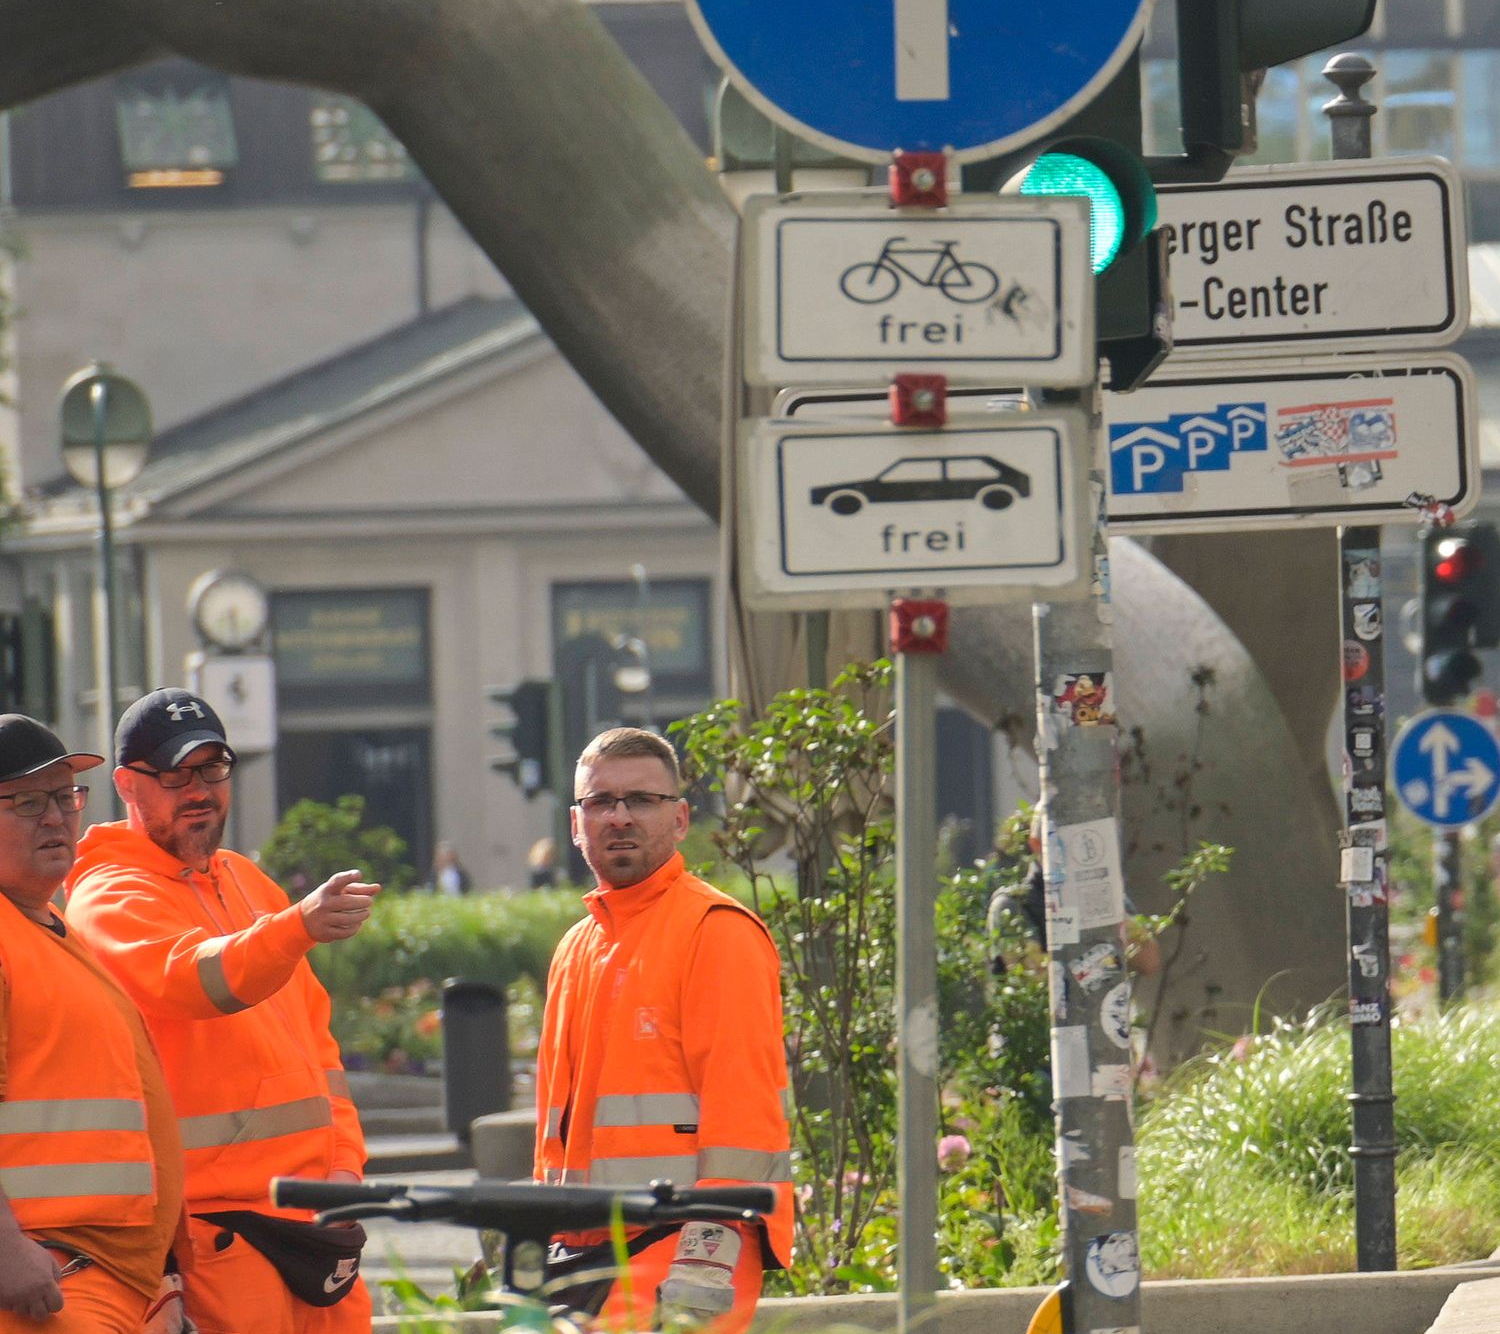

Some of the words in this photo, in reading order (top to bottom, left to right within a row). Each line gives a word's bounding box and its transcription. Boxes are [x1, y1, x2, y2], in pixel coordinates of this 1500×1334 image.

[1285, 200, 1412, 248] Straße
[878, 315, 964, 344] frei
[881, 522, 967, 553] frei
